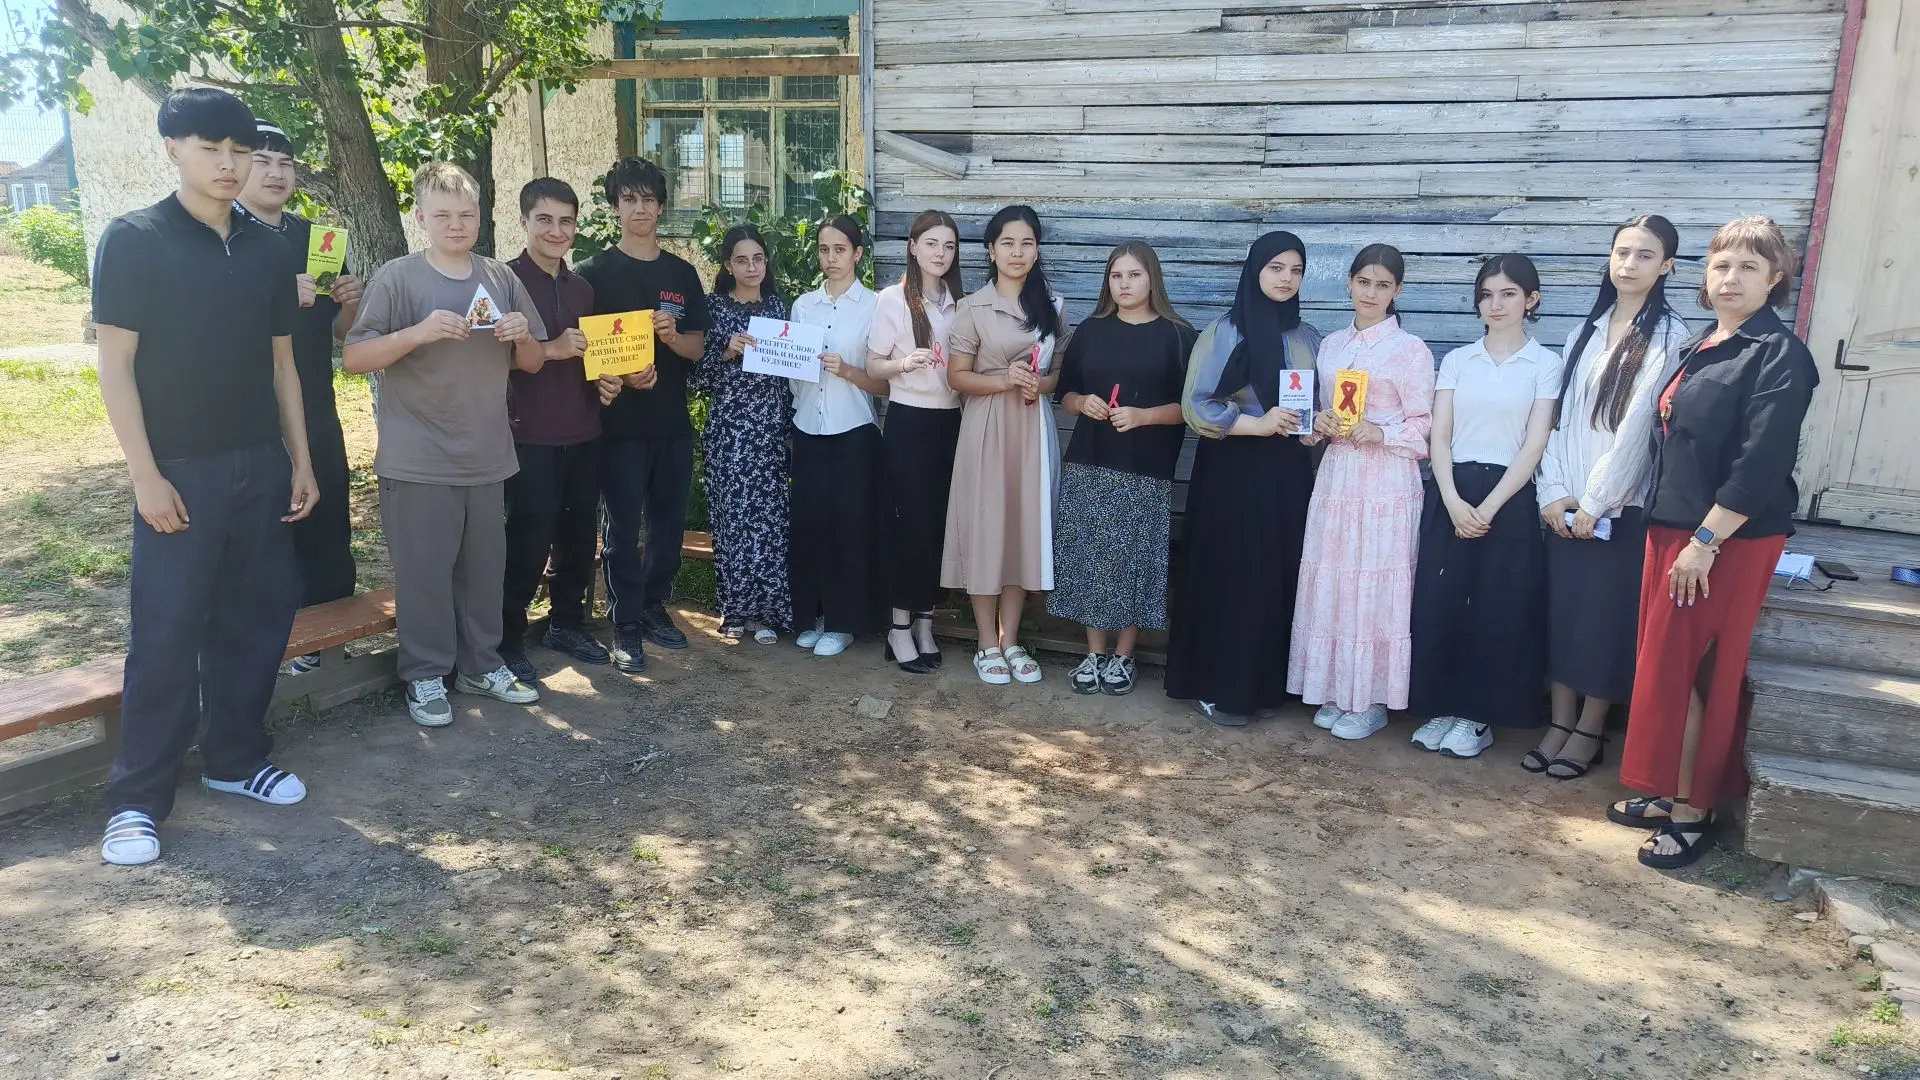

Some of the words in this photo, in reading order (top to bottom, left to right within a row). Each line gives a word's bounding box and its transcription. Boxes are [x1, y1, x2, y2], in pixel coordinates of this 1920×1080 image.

[660, 291, 685, 304] NASA
[625, 333, 649, 343] СВОЮ
[589, 348, 617, 357] ЖИЗНЬ
[618, 346, 624, 354] И
[625, 343, 647, 352] НАШЕ
[755, 337, 790, 350] ЕРЕГИТЕ
[790, 344, 816, 354] СВОЮ
[601, 353, 639, 365] БУДУЩЕЕ!
[752, 346, 779, 356] ЖИЗНЬ
[780, 350, 787, 358] И
[788, 352, 812, 363] НАШЕ
[761, 356, 802, 369] БУДУЩЕЕ!
